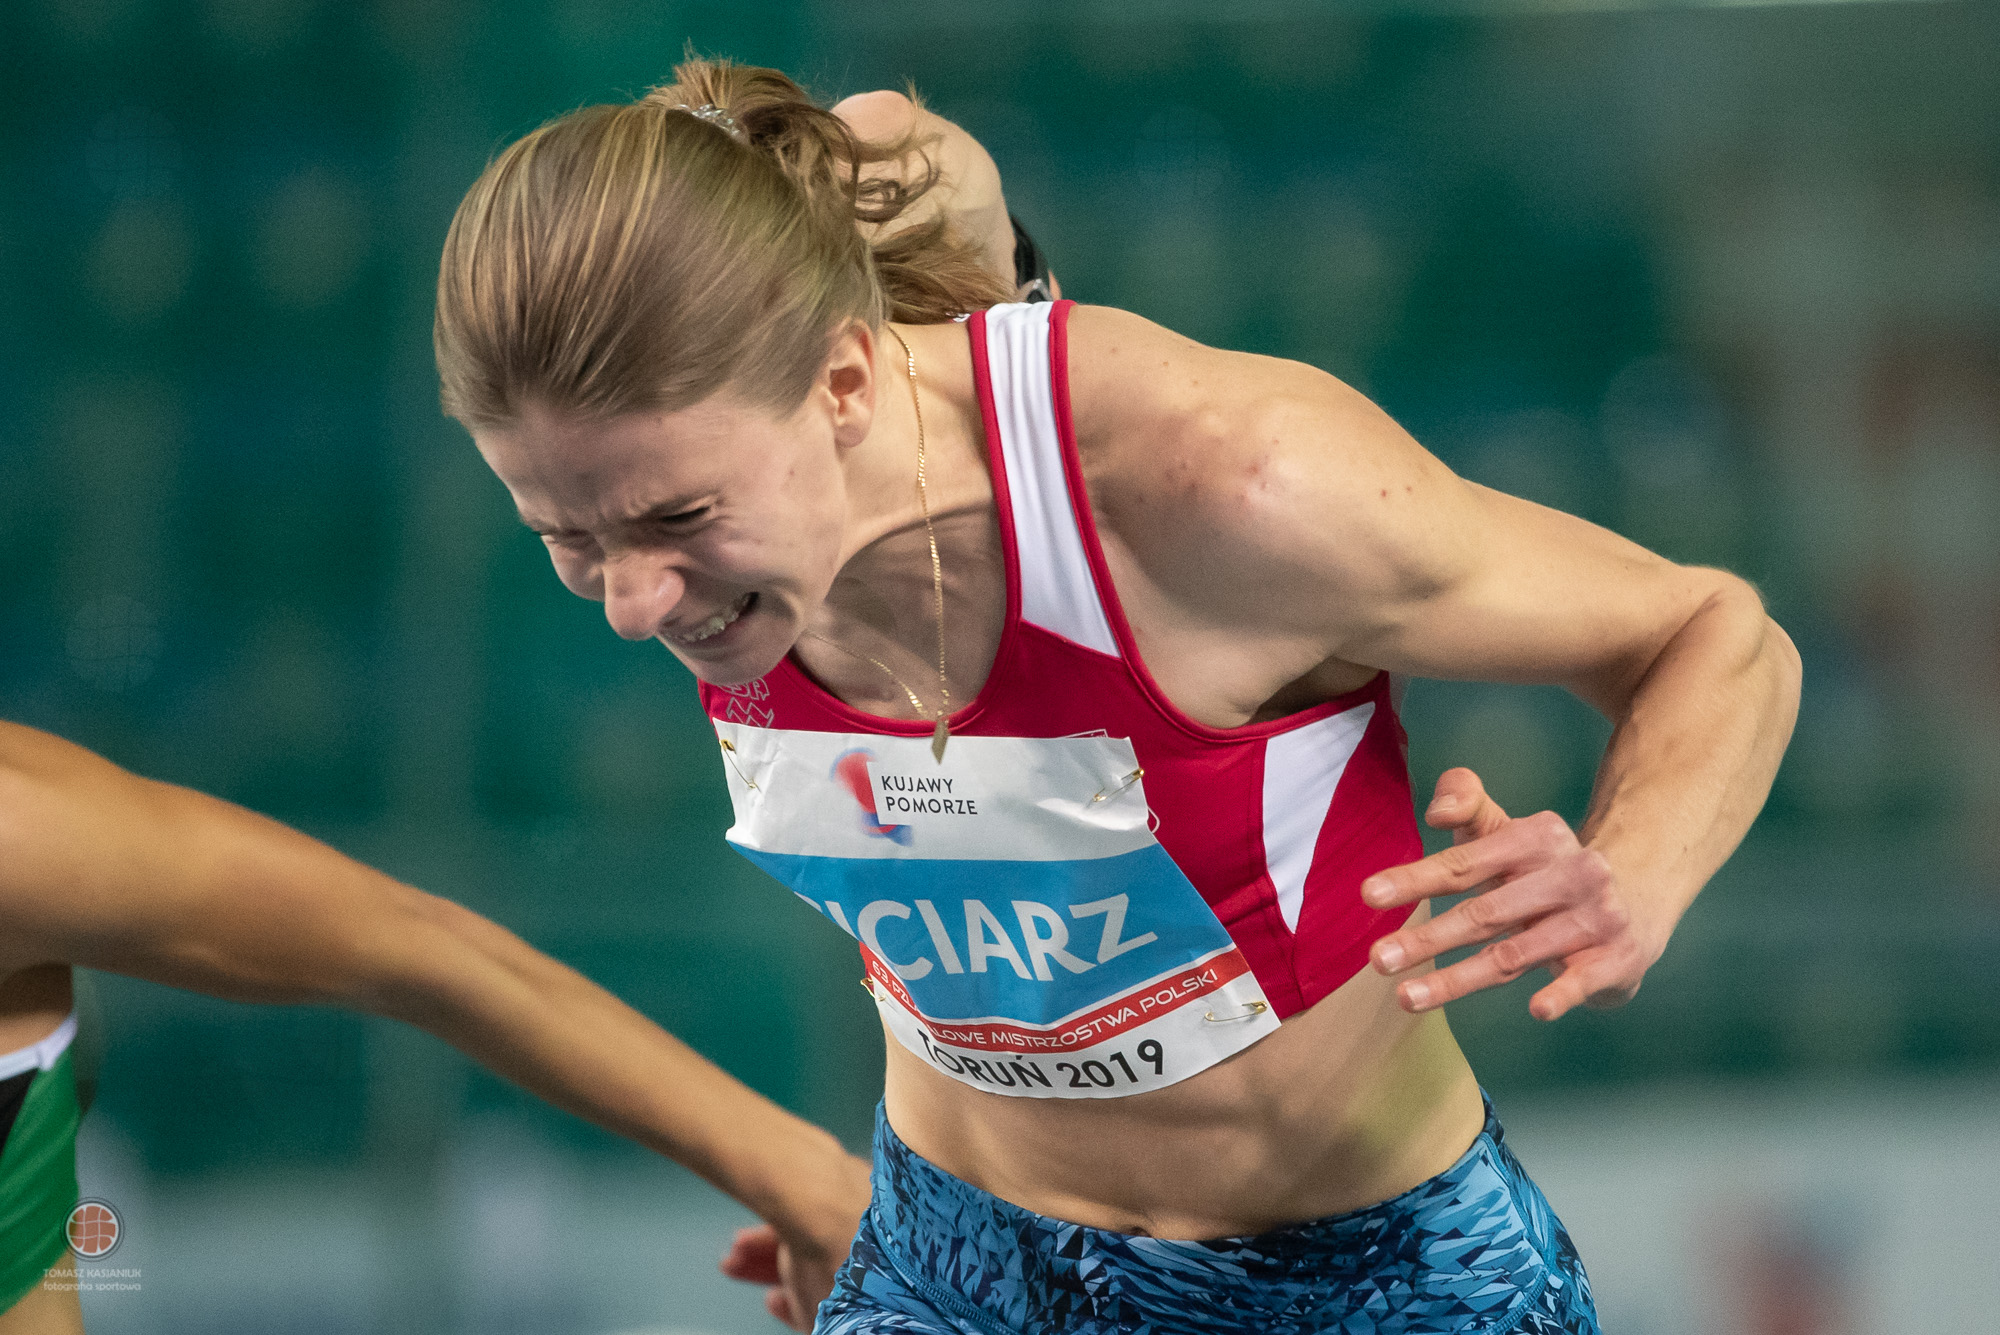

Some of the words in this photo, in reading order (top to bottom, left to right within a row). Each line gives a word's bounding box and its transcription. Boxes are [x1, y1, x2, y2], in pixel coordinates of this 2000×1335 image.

[881, 775, 953, 794] KUJAWY
[886, 796, 978, 815] POMORZE
[794, 891, 1158, 982] CIARZ
[991, 1006, 1138, 1048] MISTRZOSTWA
[1141, 968, 1219, 1013] POLSKI
[917, 1027, 1053, 1088] TORUŃ
[1055, 1039, 1164, 1088] 2019
